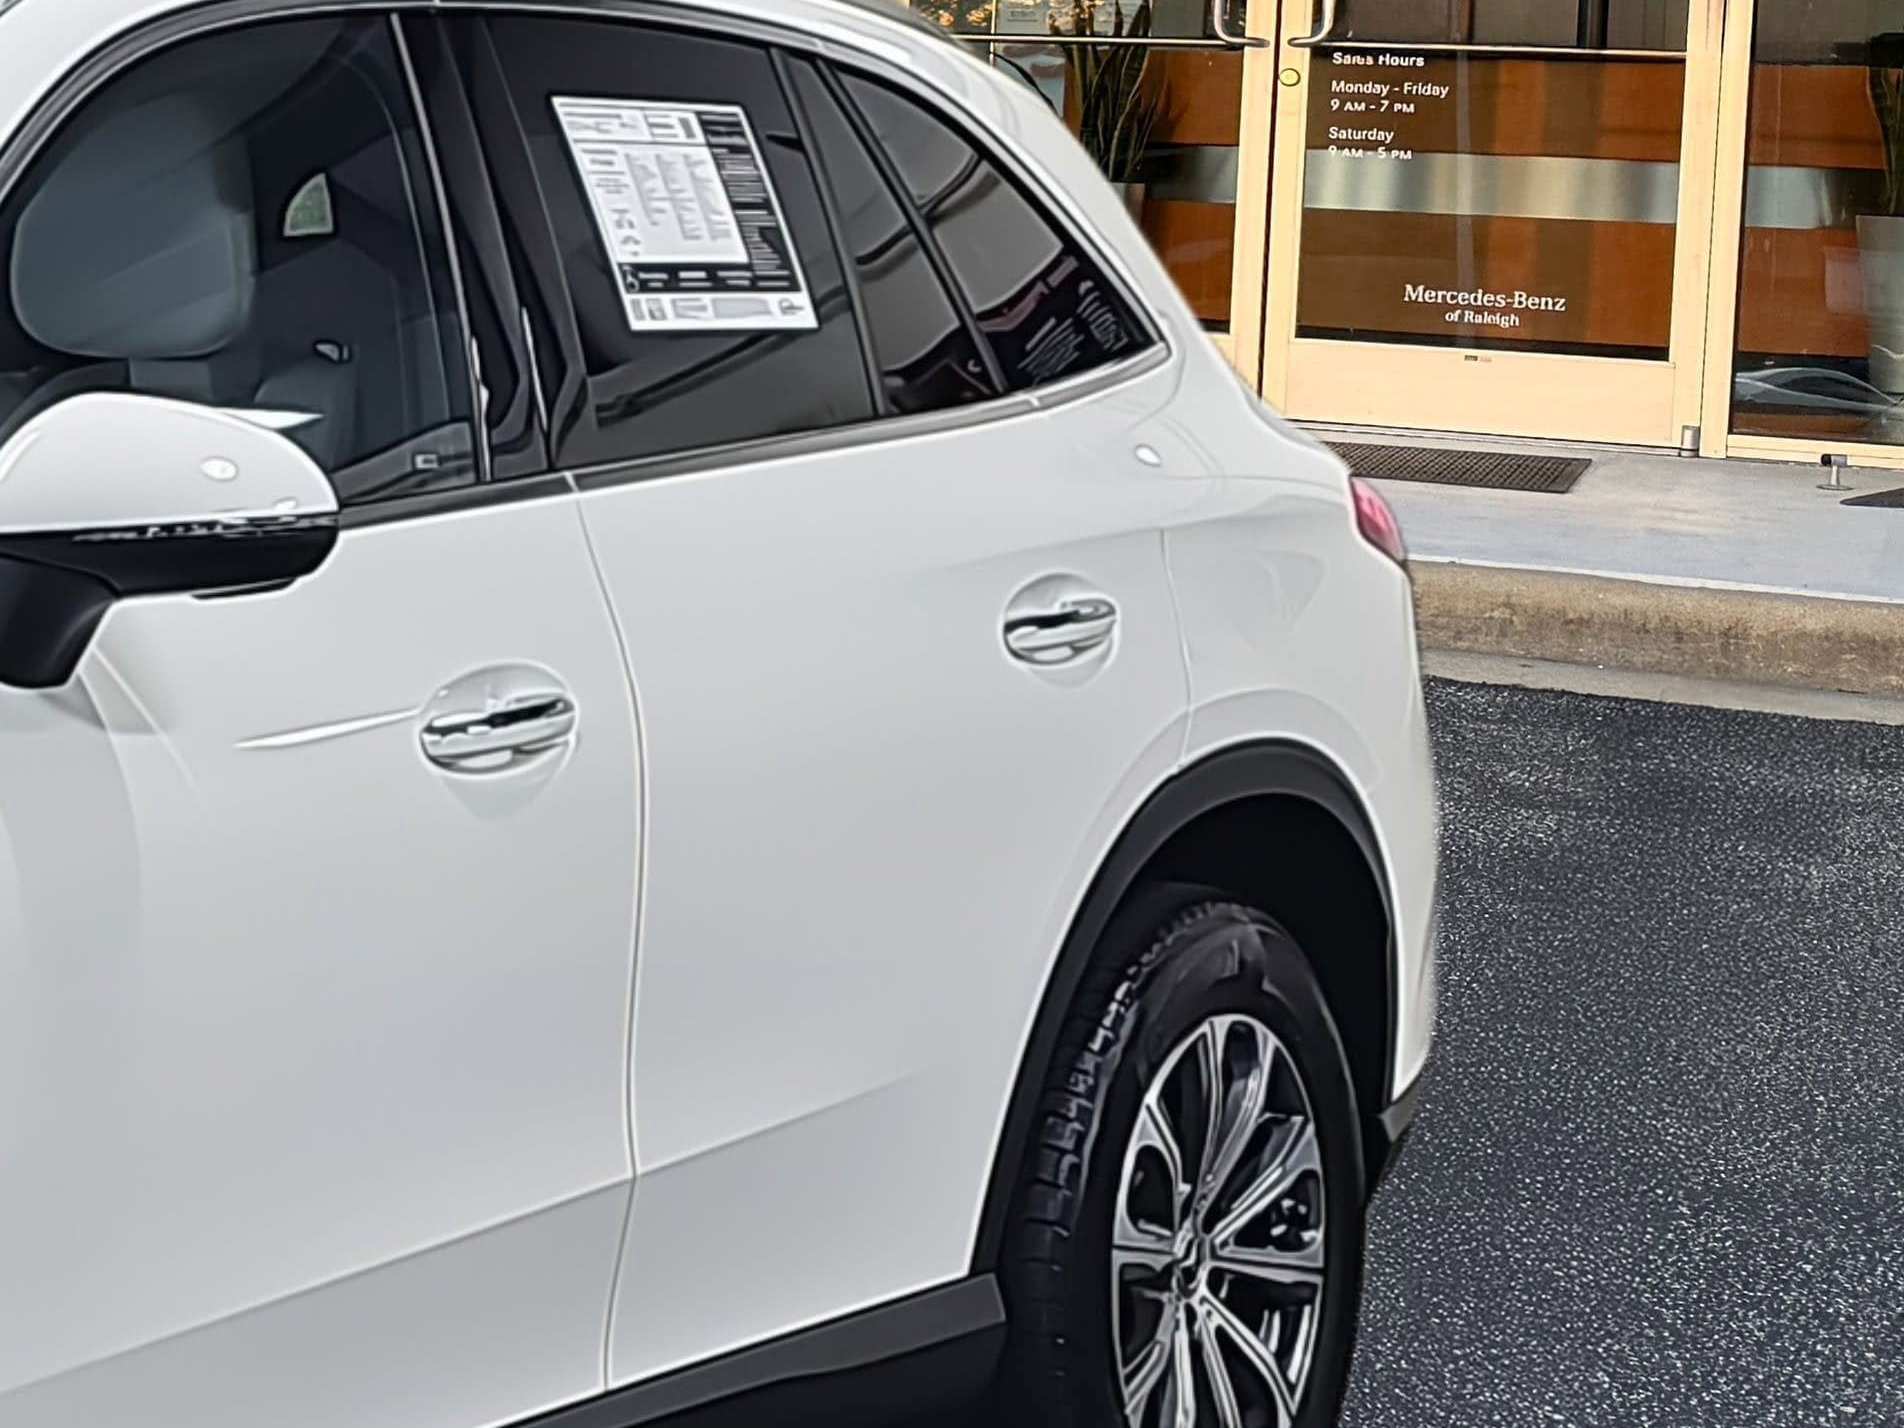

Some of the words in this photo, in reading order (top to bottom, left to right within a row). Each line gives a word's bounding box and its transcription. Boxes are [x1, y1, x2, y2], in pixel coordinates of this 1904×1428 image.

[1378, 53, 1425, 67] Hours
[1331, 80, 1390, 97] Monday
[1403, 82, 1450, 99] Friday
[1330, 98, 1340, 112] 9
[1344, 101, 1366, 112] AM
[1379, 100, 1389, 113] 7
[1393, 103, 1415, 114] PM
[1328, 126, 1394, 144] Saturday
[1328, 145, 1338, 157] 9
[1342, 148, 1364, 158] AM
[1377, 146, 1387, 159] 5
[1391, 149, 1413, 160] PM
[1403, 284, 1567, 312] Mercedes-Benz
[1444, 310, 1461, 323] of
